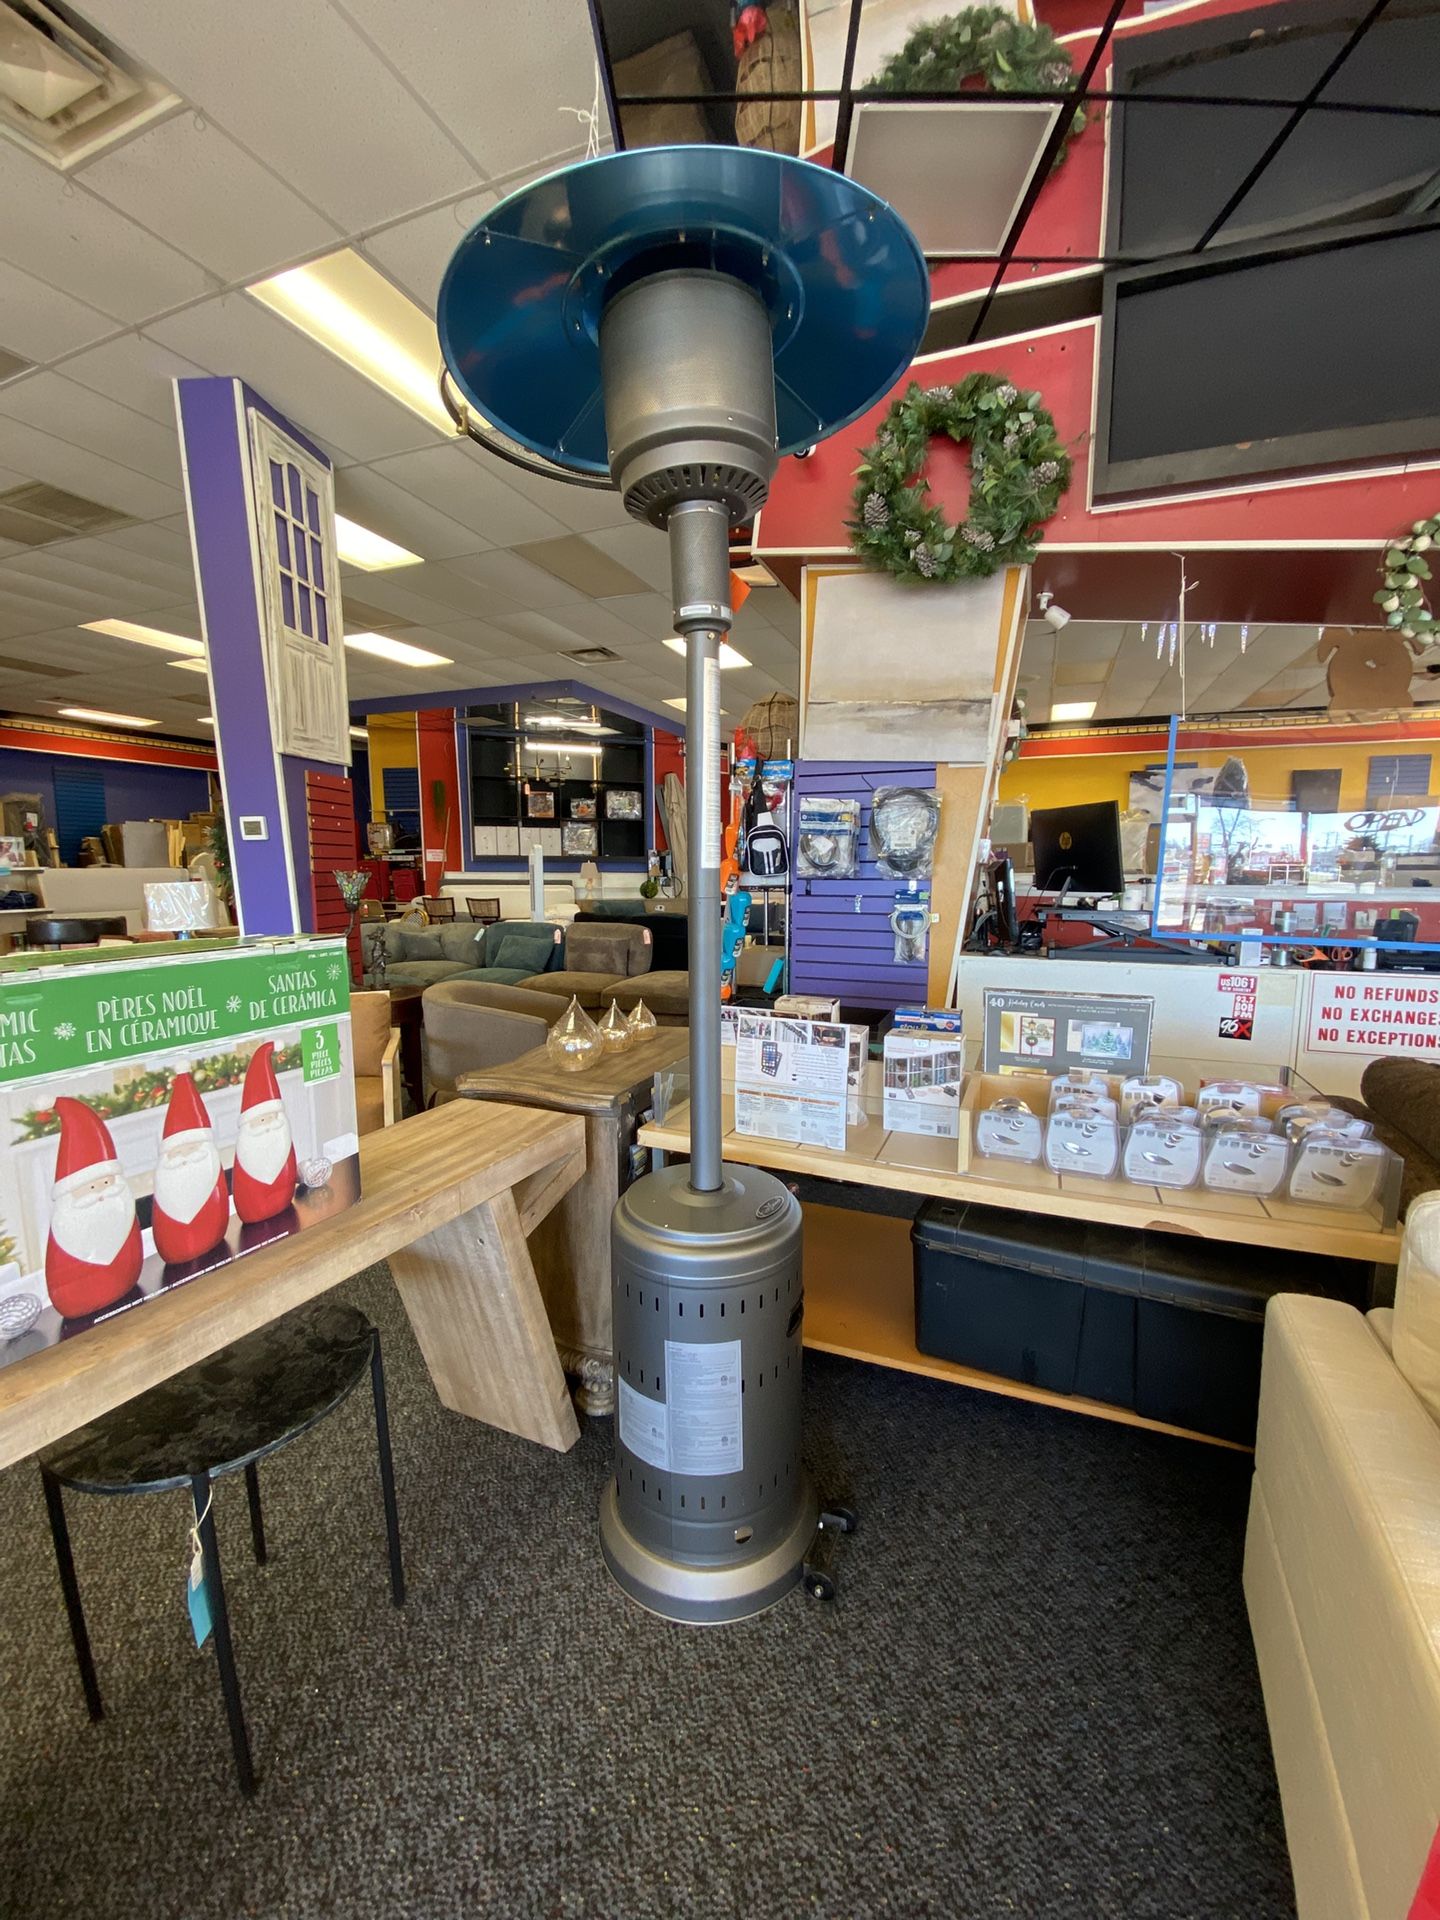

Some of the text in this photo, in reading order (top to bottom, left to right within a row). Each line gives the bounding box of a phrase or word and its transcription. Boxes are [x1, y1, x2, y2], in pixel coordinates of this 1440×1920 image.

[1344, 808, 1426, 833] OPEN
[268, 969, 317, 995] SANTAS
[97, 985, 207, 1024] PÈRES NOËL
[249, 988, 337, 1020] DE CERÁMICA
[989, 997, 1005, 1008] 40
[1236, 995, 1255, 1004] 93.7
[1334, 985, 1439, 1004] NO REFUNDS
[1233, 1011, 1253, 1019] FM
[1234, 1002, 1254, 1013] BOB
[1321, 1006, 1440, 1026] NO EXCHANGE
[85, 1009, 220, 1054] EN CÉRAMIQUE
[314, 1029, 325, 1050] 3
[1317, 1027, 1440, 1048] NO EXCEPTION
